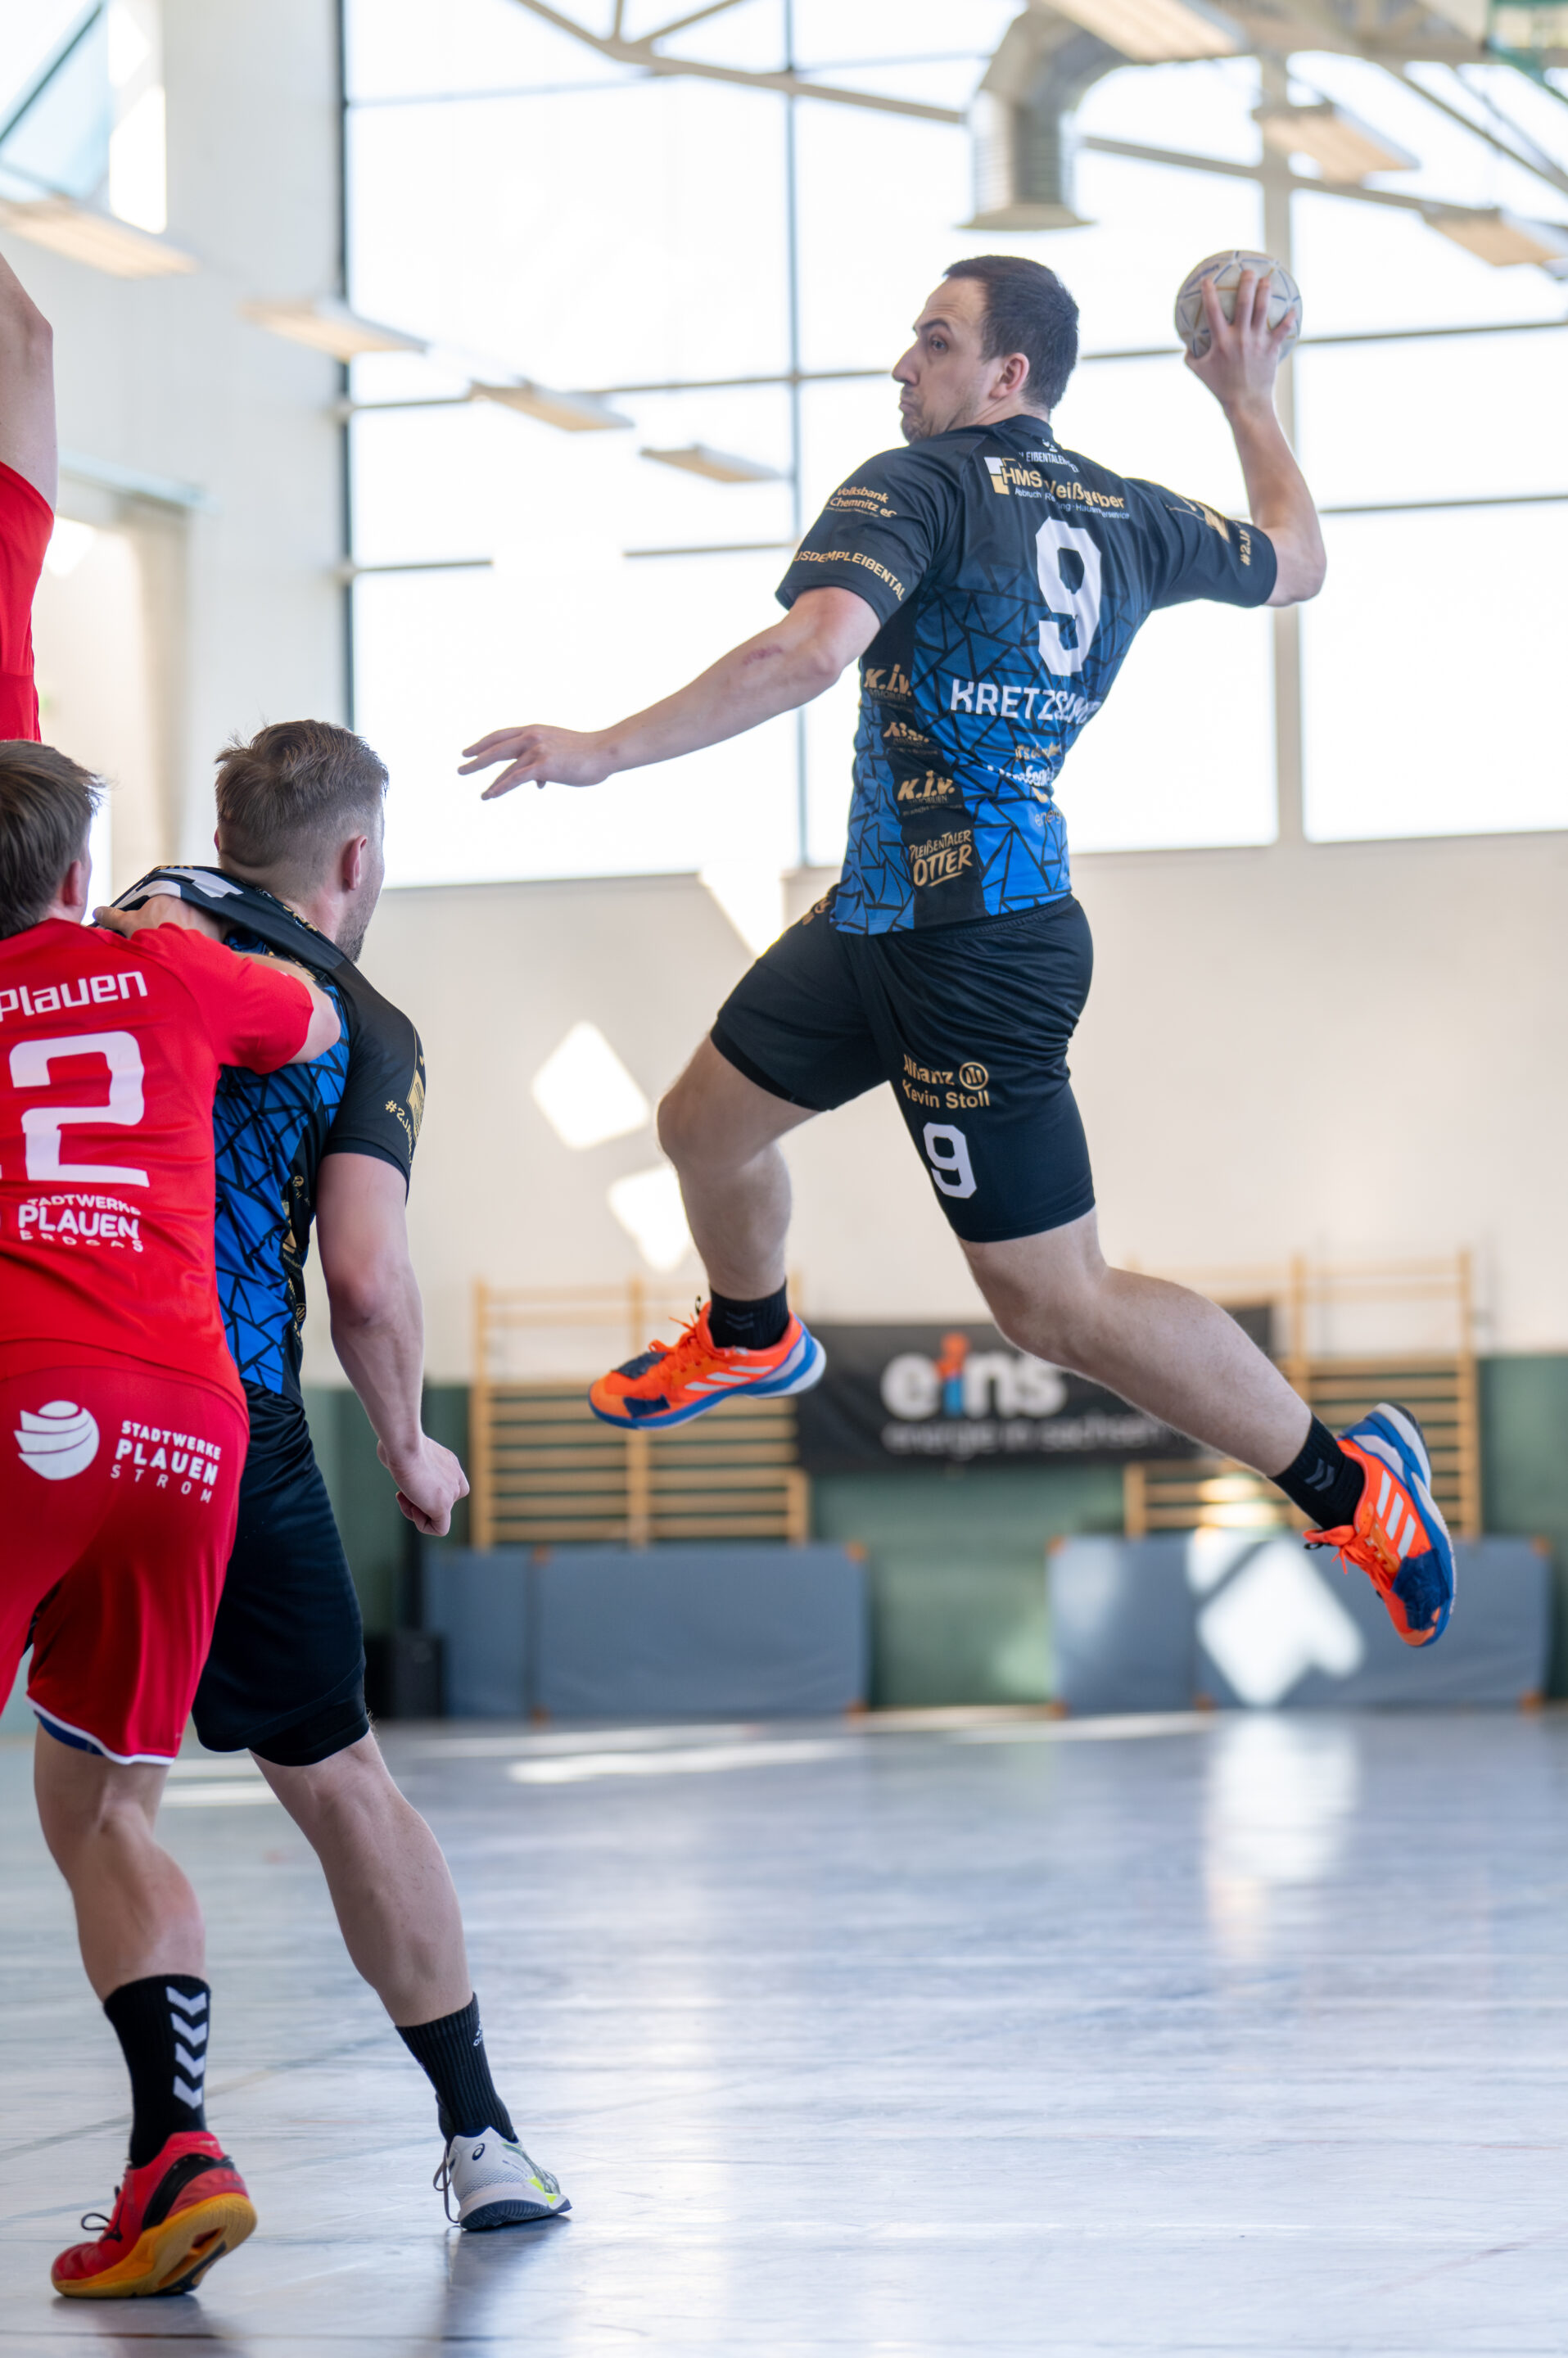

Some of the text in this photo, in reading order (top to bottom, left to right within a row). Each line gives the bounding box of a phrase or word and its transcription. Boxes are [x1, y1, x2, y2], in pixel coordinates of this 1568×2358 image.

[837, 486, 889, 504] Volksbank
[1002, 468, 1043, 488] HMS
[830, 497, 879, 512] Chemnitz
[1035, 516, 1102, 676] 9
[909, 829, 972, 862] PLEIßENTALER
[913, 843, 974, 887] OTTER
[0, 970, 148, 1023] Plauen
[901, 1078, 991, 1109] Kevin Stoll
[922, 1122, 978, 1199] 9
[18, 1204, 139, 1240] PLAUEN
[26, 1194, 142, 1216] TADTWERKE
[880, 1332, 1068, 1421] eins
[121, 1420, 222, 1461] STADTWERKE
[115, 1438, 219, 1486] PLAUEN
[110, 1464, 213, 1504] STROM
